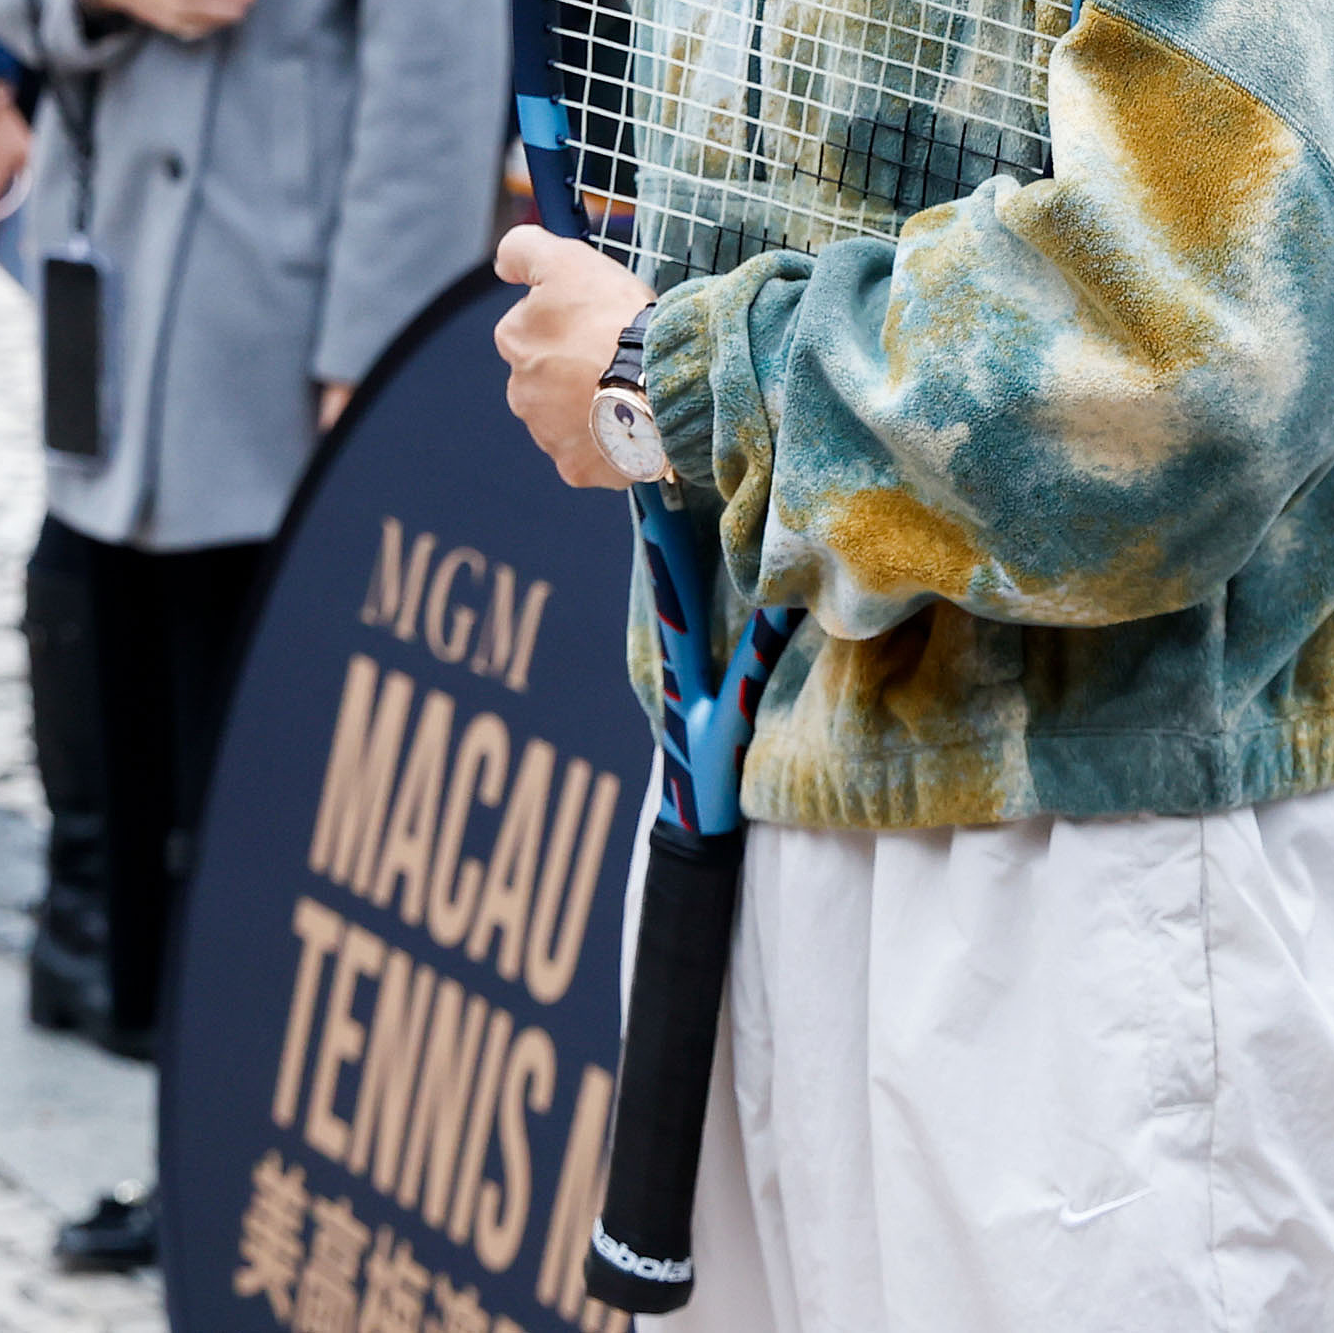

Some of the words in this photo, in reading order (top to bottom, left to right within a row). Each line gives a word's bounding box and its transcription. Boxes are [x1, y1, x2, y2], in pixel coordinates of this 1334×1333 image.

[361, 516, 551, 693] MGM
[308, 652, 620, 1004] MACAU
[271, 895, 557, 1273] TENNIS
